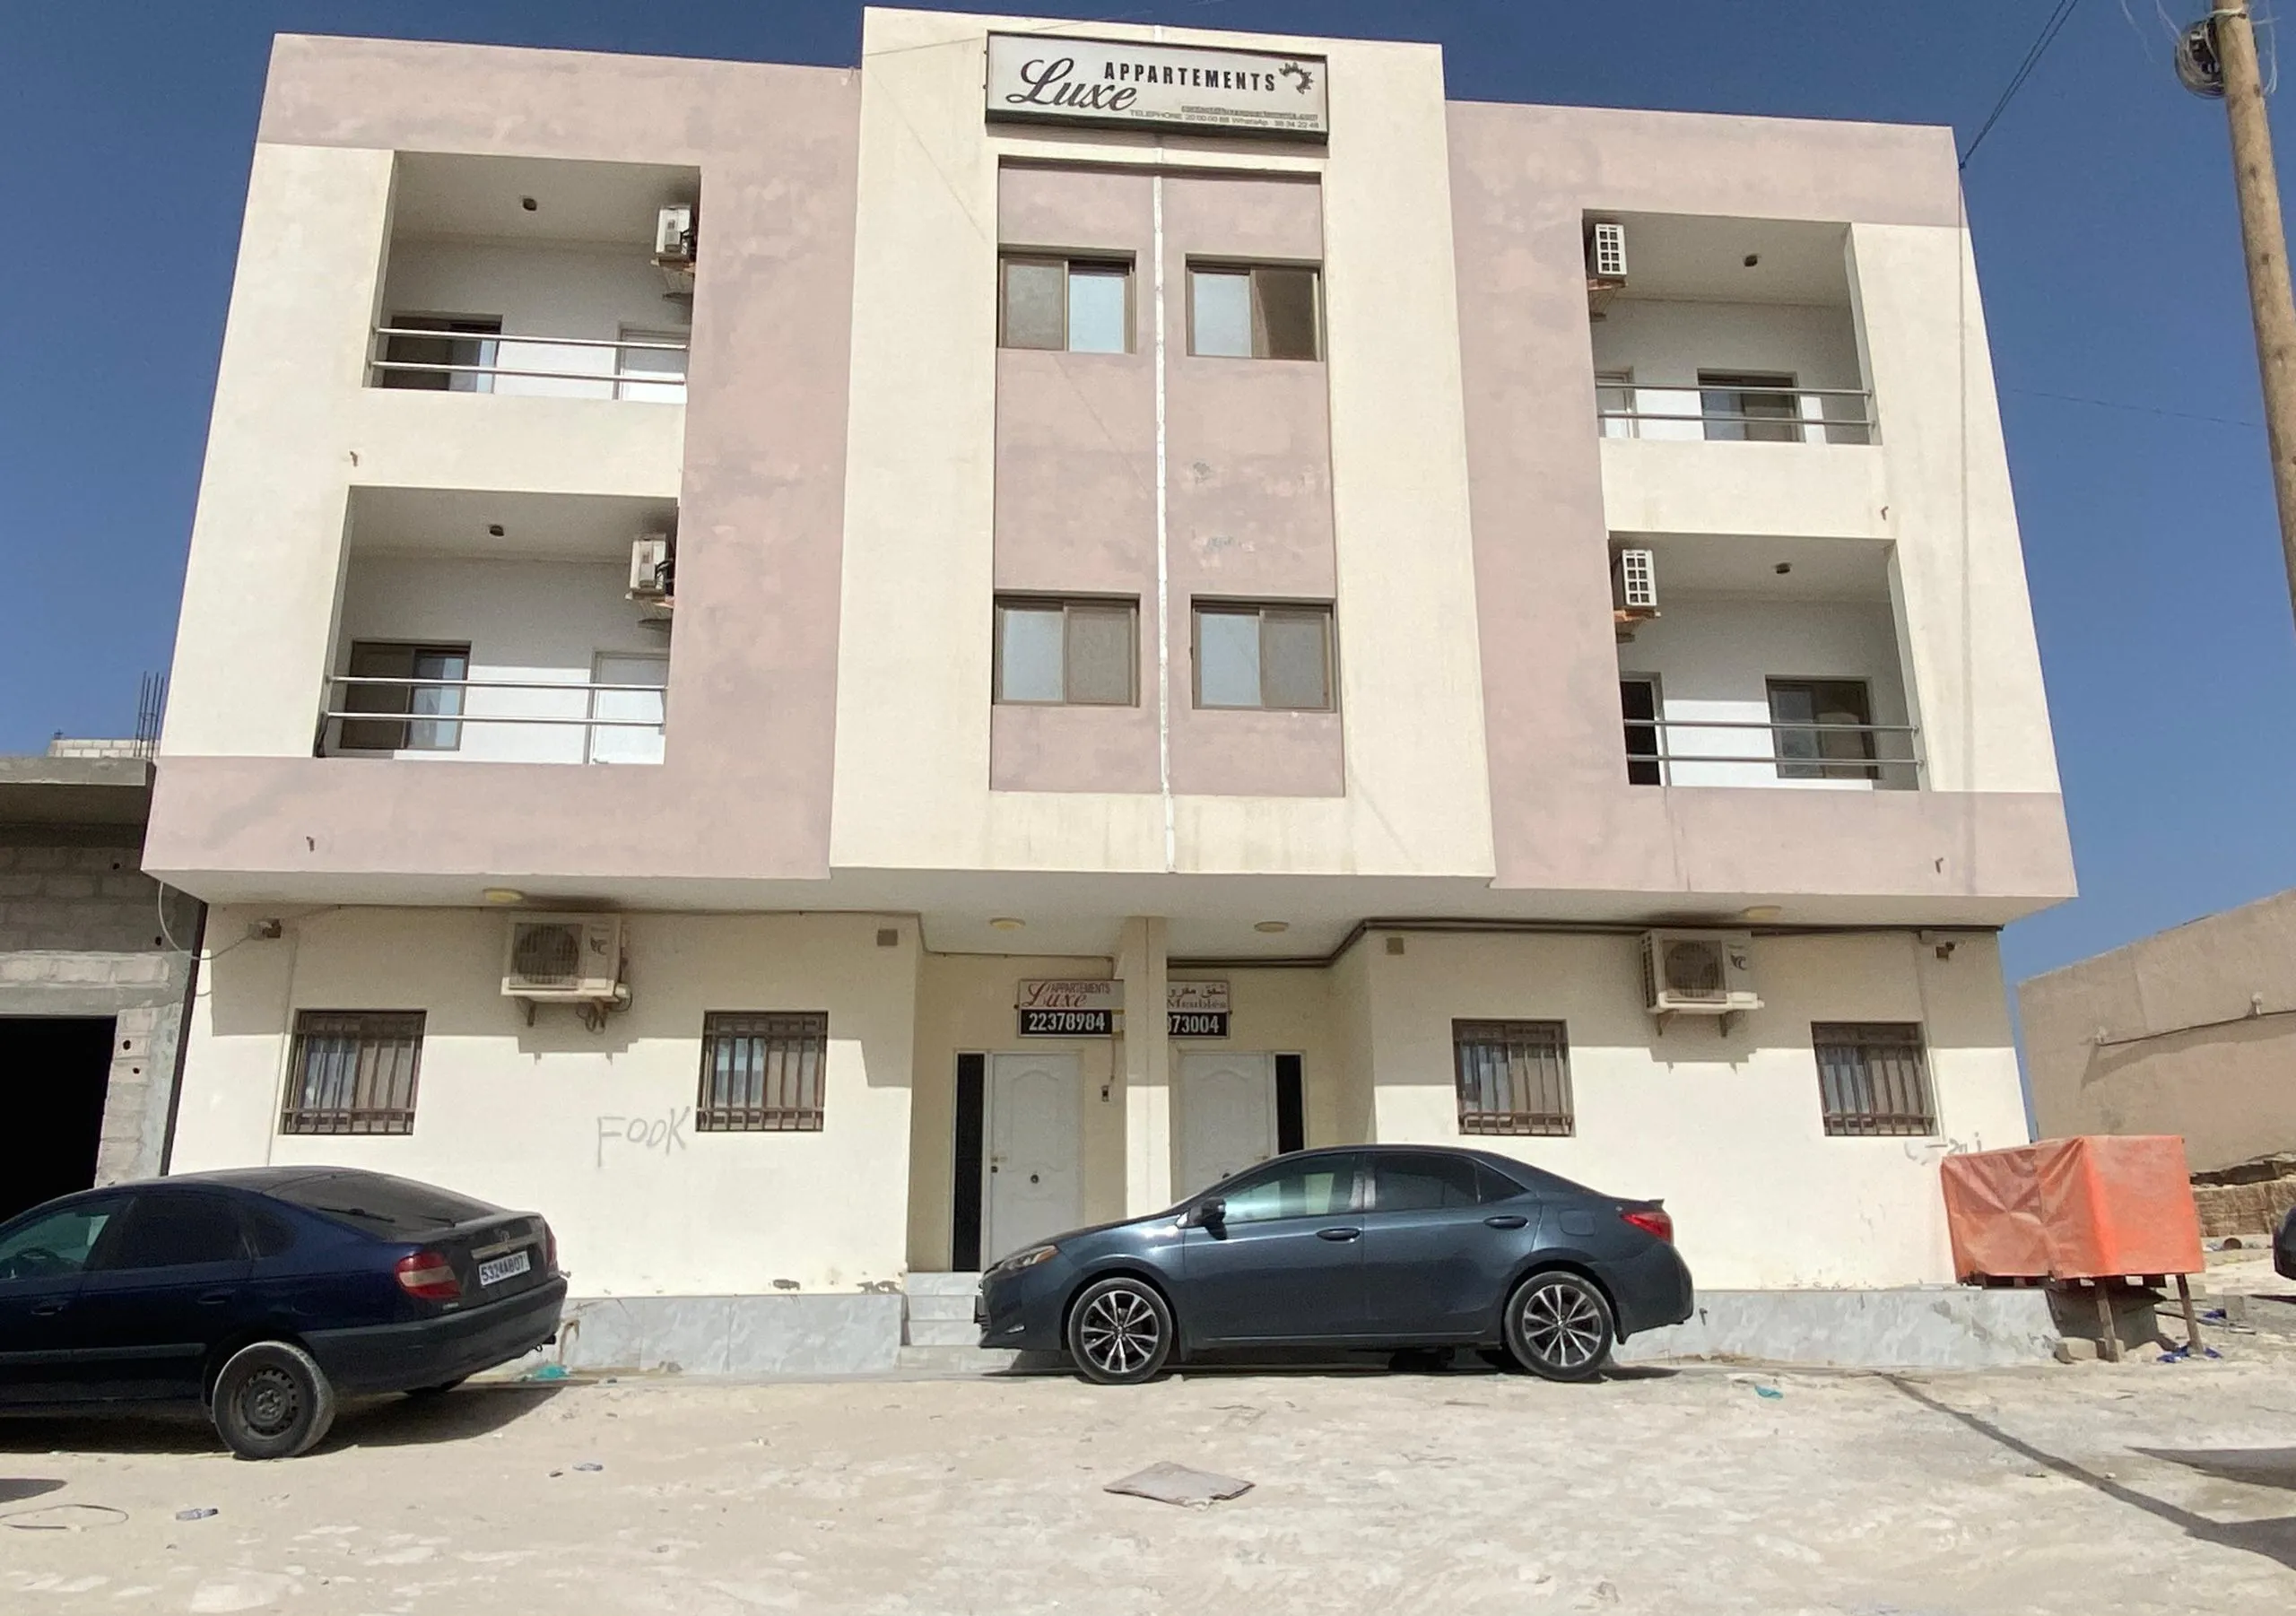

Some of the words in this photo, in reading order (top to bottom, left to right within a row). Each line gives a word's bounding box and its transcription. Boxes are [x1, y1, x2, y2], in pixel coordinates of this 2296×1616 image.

[1005, 57, 1137, 111] Luxe
[1104, 61, 1274, 91] APPARTEMENTS
[1022, 980, 1088, 1007] Luxe
[1047, 982, 1110, 995] APPARTEMENTS
[1029, 1012, 1106, 1032] 22378984
